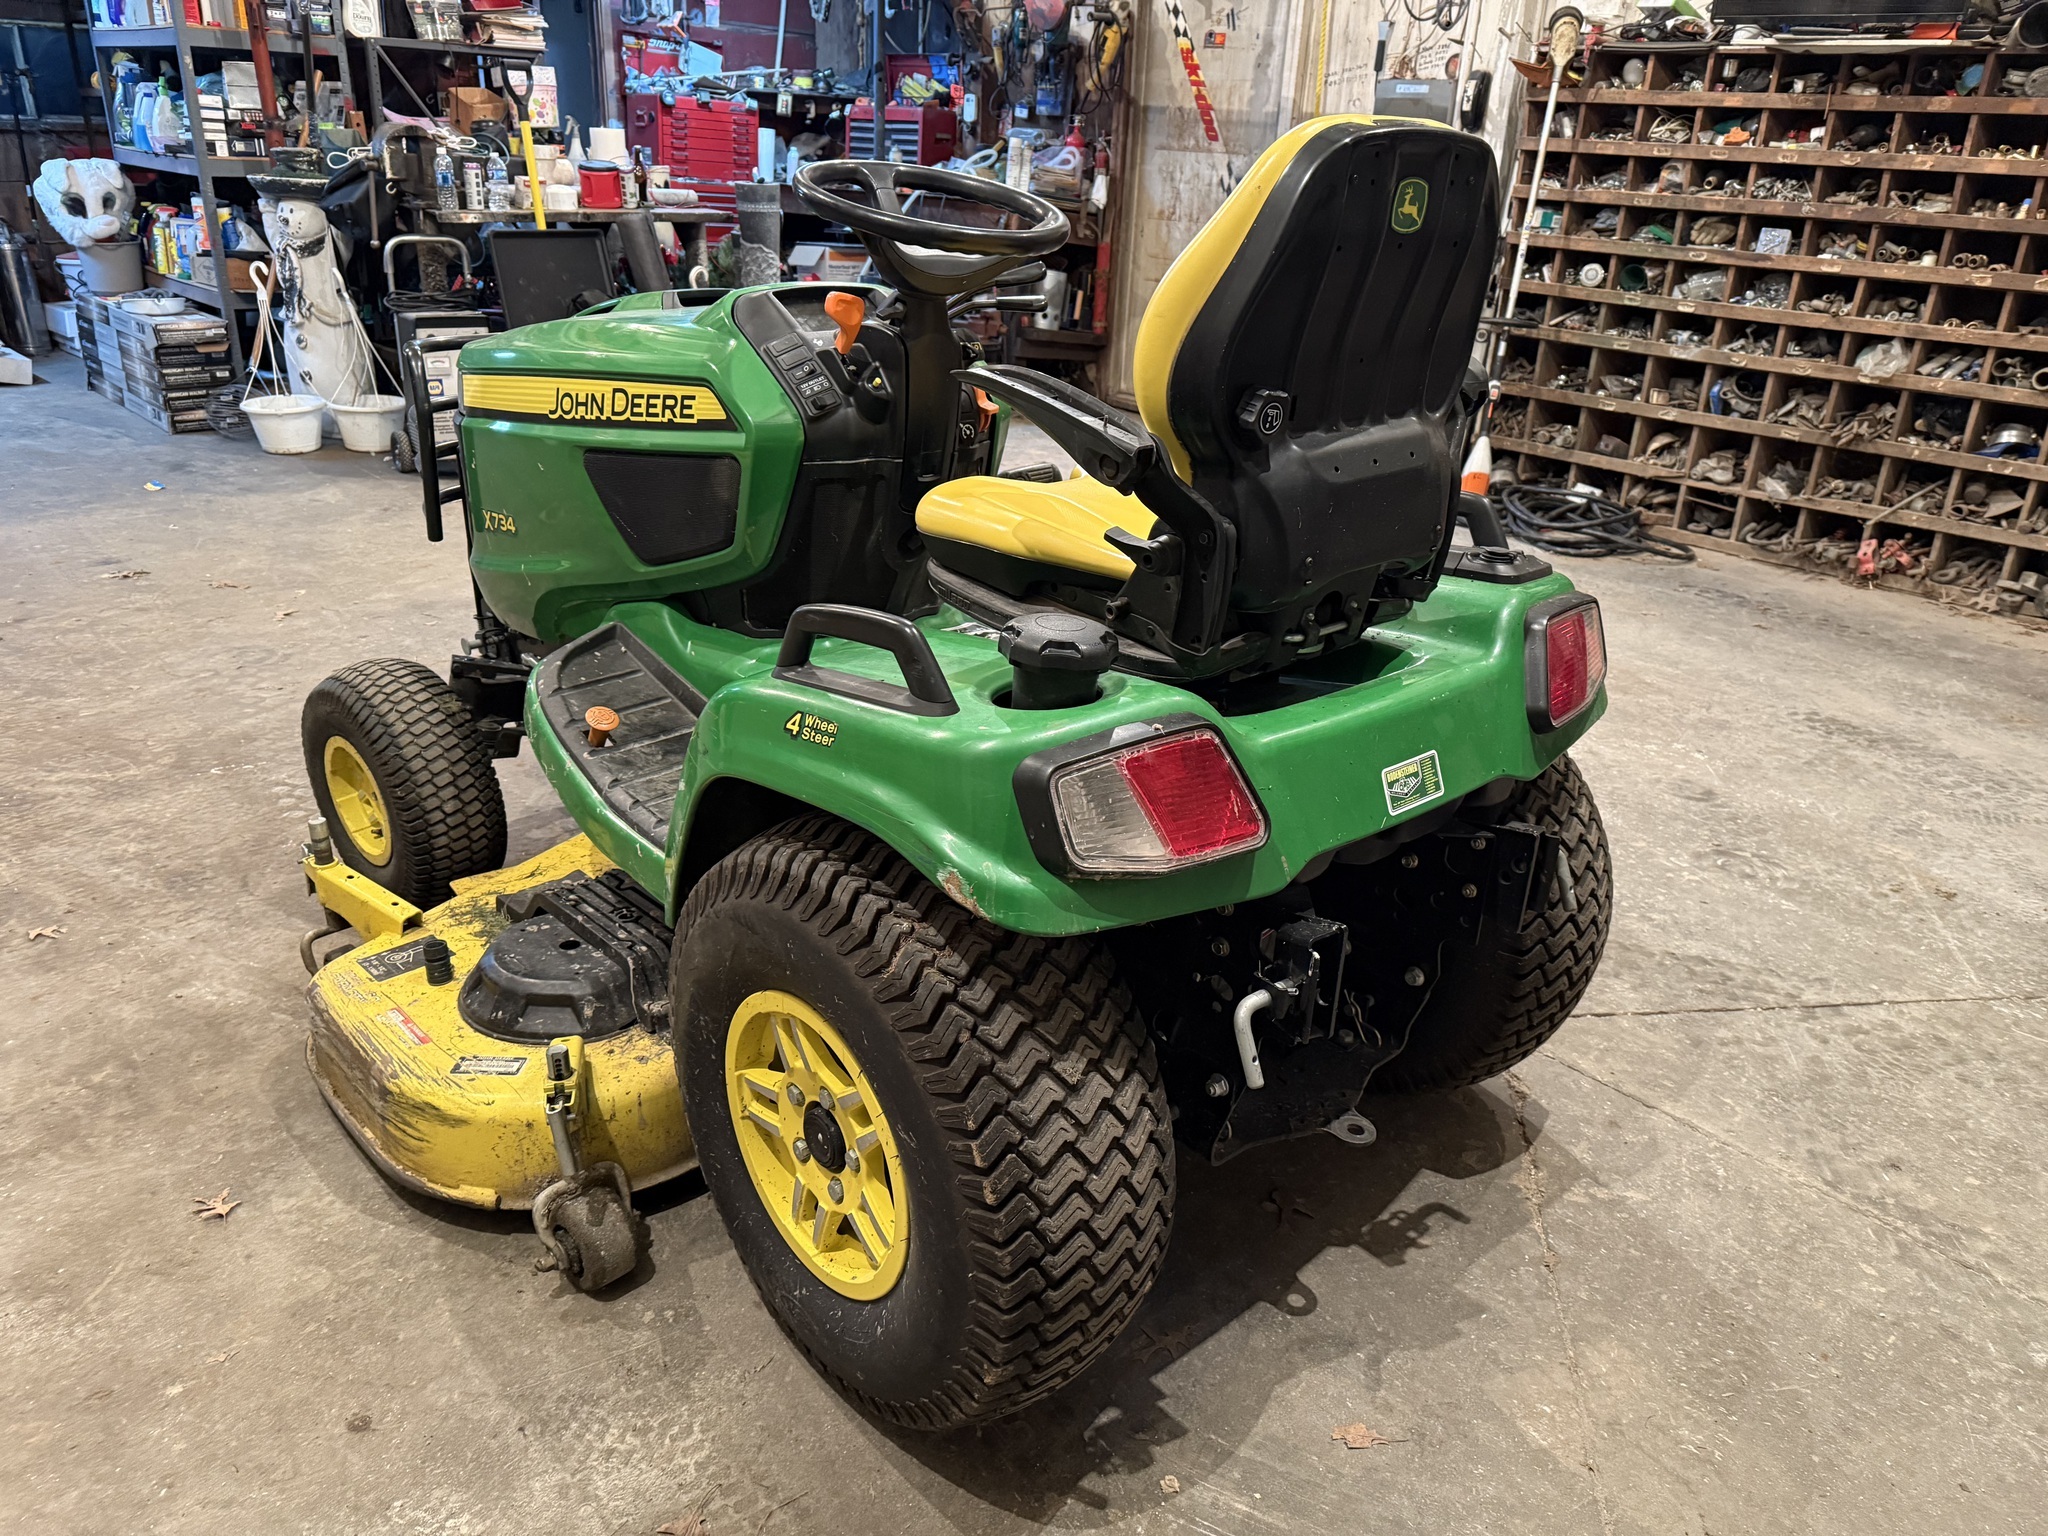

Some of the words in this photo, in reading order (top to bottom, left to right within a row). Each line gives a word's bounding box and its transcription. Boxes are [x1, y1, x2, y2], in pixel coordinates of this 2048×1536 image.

[1180, 47, 1219, 142] SKI-DOO
[548, 387, 605, 419] JOHN
[610, 387, 697, 423] DEERE
[483, 509, 516, 534] X734
[784, 711, 803, 738] 4
[804, 713, 839, 735] Wheel
[801, 726, 835, 747] Steer
